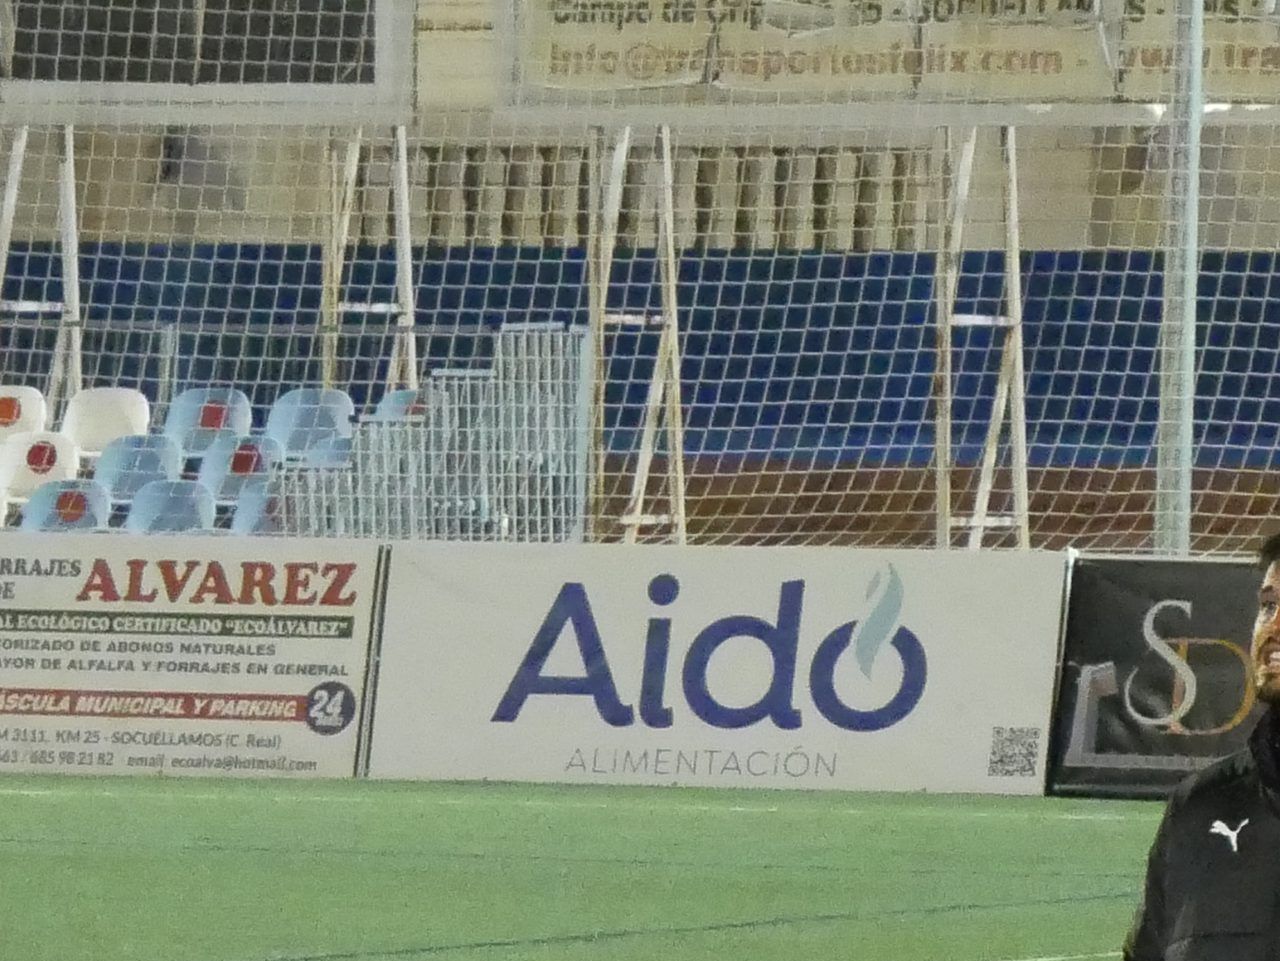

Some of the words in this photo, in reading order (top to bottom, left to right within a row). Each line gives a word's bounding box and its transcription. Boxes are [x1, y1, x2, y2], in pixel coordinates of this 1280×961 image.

[0, 581, 16, 600] E
[76, 558, 357, 606] ALVAREZ
[18, 612, 110, 631] ECOLÓGICO
[113, 616, 222, 633] CERTIFICADO
[80, 640, 101, 651] DE
[106, 641, 174, 653] ABONOS
[180, 643, 276, 656] NATURALES
[490, 574, 928, 732] Aido
[41, 658, 61, 670] DE
[67, 660, 135, 672] ALFALFA
[142, 661, 153, 672] Y
[157, 661, 240, 675] FORRAJES
[246, 663, 267, 675] EN
[274, 663, 348, 676] GENERAL
[75, 696, 185, 715] MUNICIPAL
[194, 698, 209, 714] Y
[208, 699, 297, 717] PARKING
[309, 689, 345, 719] 24
[565, 746, 837, 778] ALIMENTACIÓN
